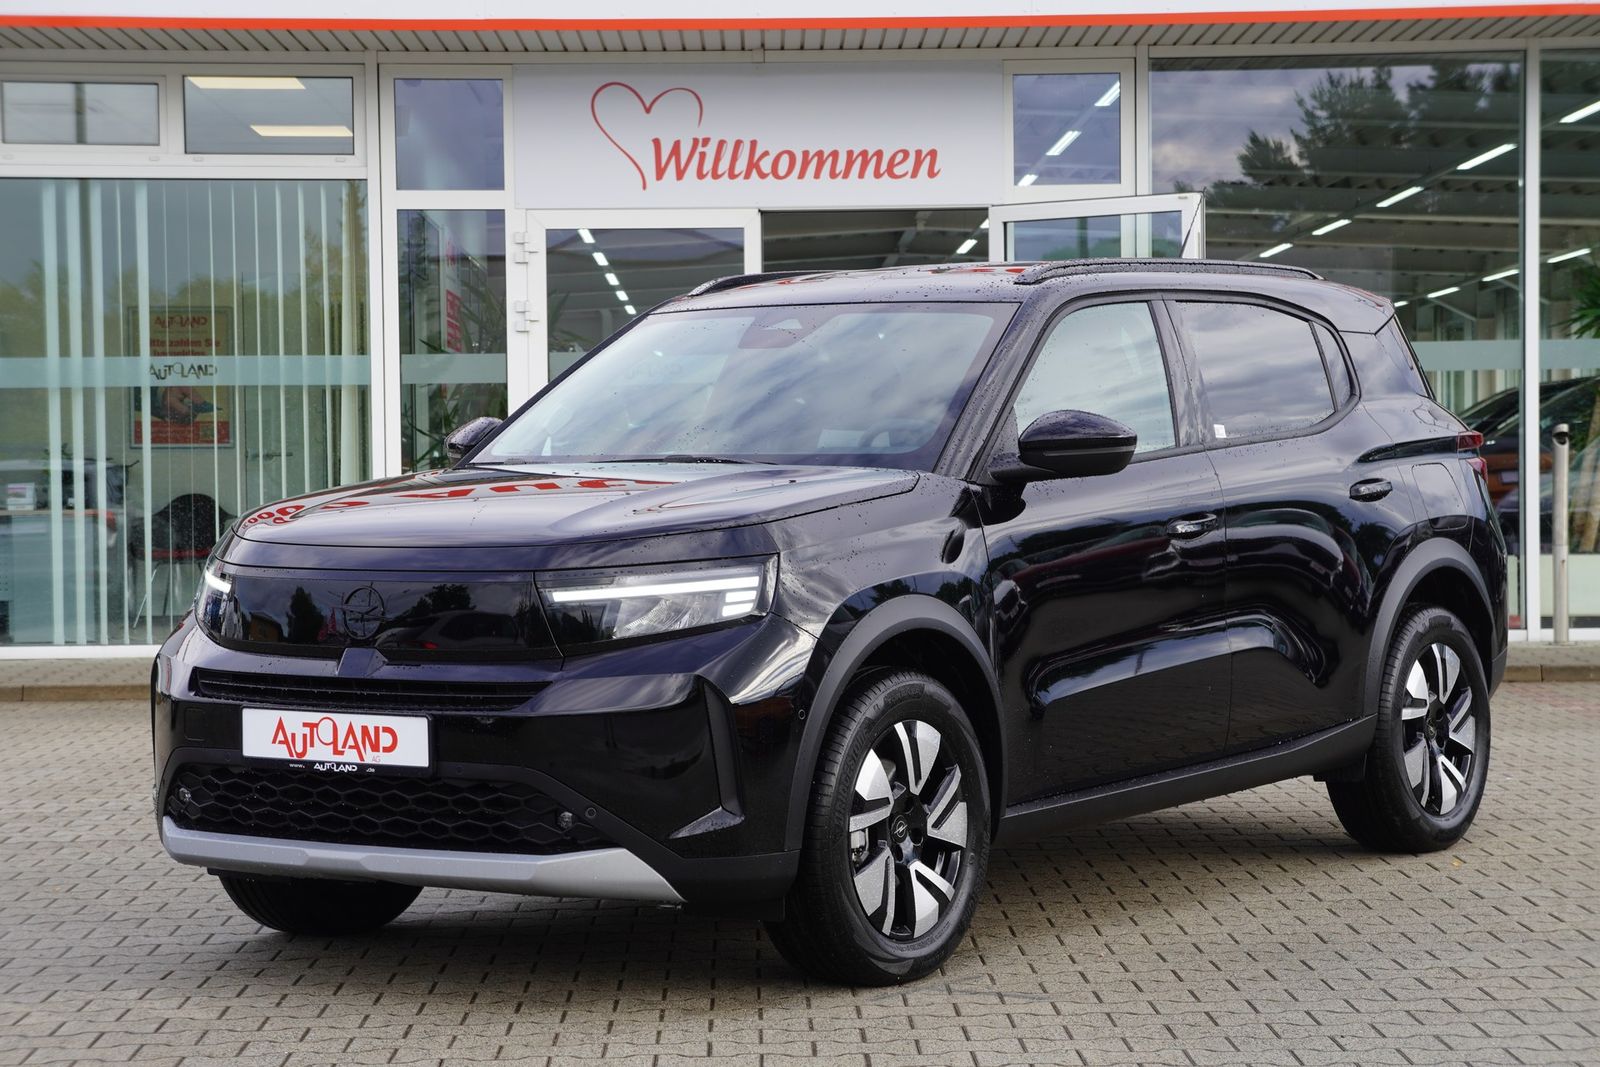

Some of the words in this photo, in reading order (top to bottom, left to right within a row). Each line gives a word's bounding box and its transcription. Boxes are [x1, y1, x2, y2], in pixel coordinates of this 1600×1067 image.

[651, 136, 941, 182] Willkommen
[149, 361, 218, 381] AUTOLAND
[271, 716, 399, 763] AUTOLAND
[313, 762, 358, 773] AUTOLAND
[371, 755, 382, 763] AG
